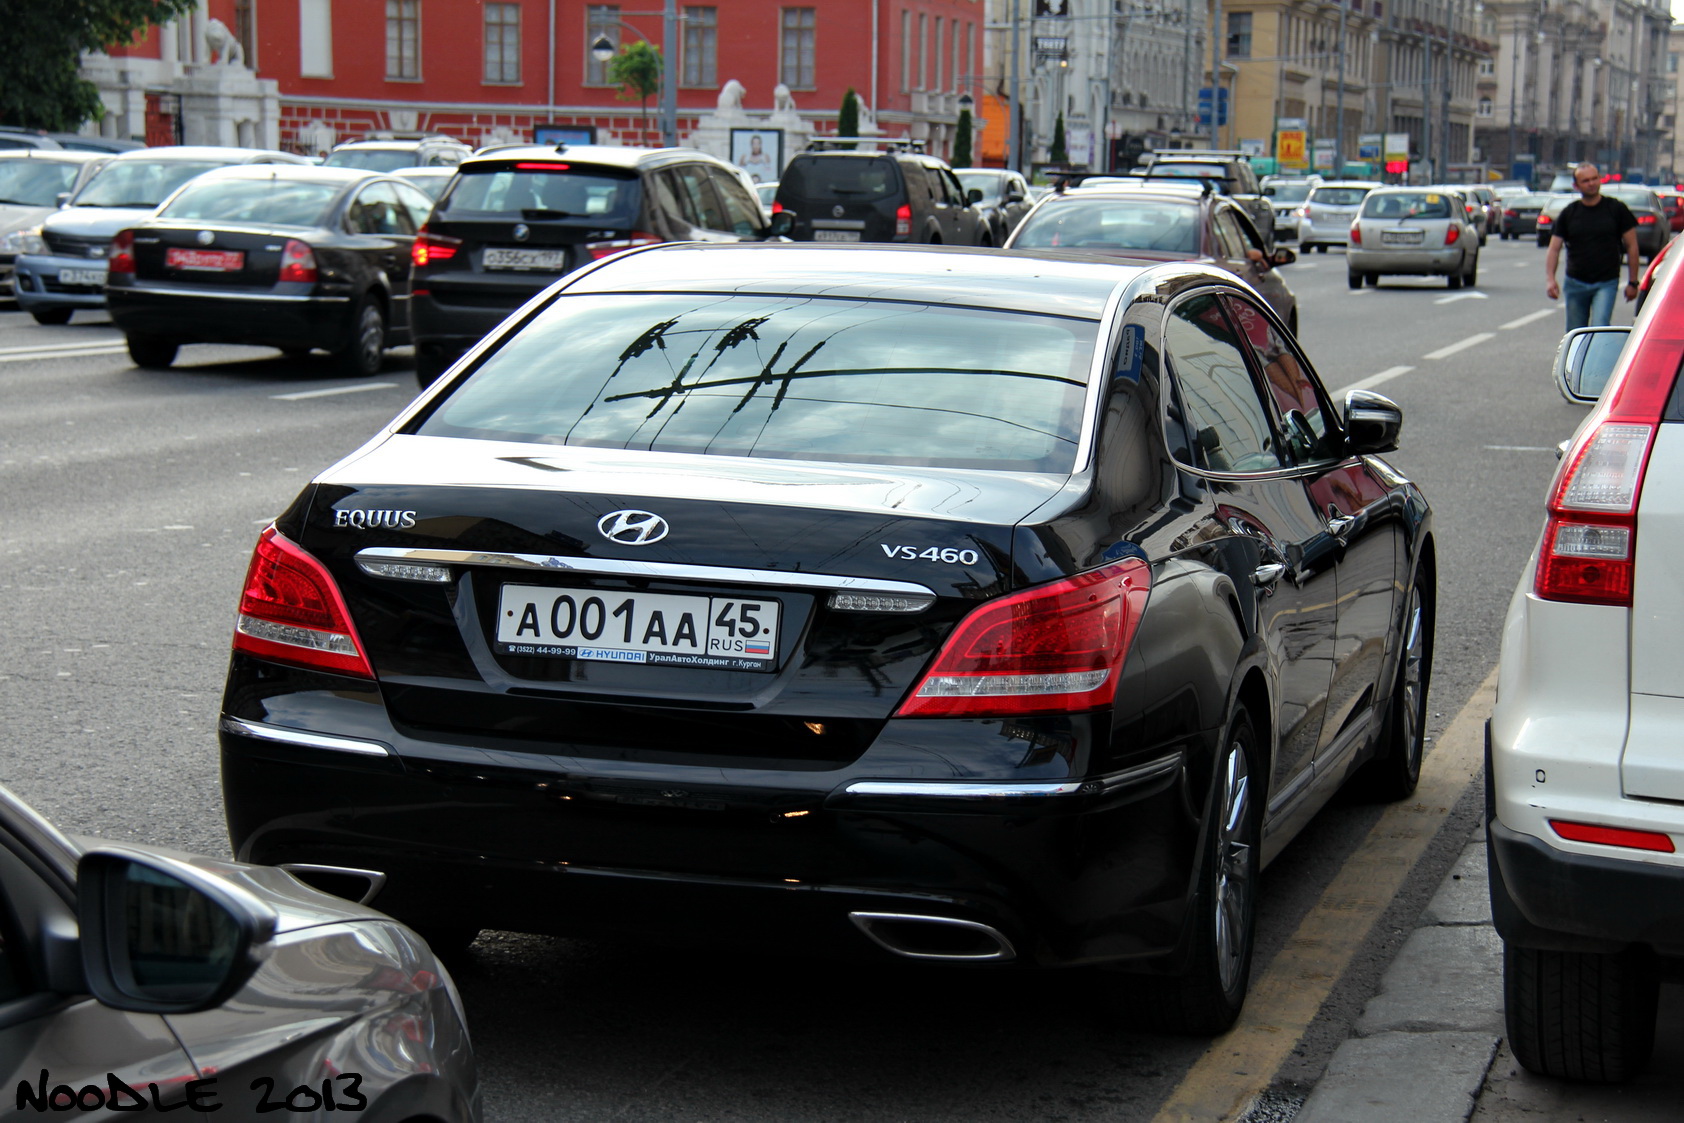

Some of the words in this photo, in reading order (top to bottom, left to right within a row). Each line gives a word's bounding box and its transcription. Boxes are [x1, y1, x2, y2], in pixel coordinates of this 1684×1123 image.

[334, 509, 417, 530] EQUUS
[880, 543, 980, 566] VS460
[715, 602, 761, 638] 45
[536, 646, 577, 656] 44-99-99
[710, 638, 744, 652] RUS
[596, 650, 645, 661] HYUNDAI
[649, 653, 730, 666] УралАвтоХолдинг
